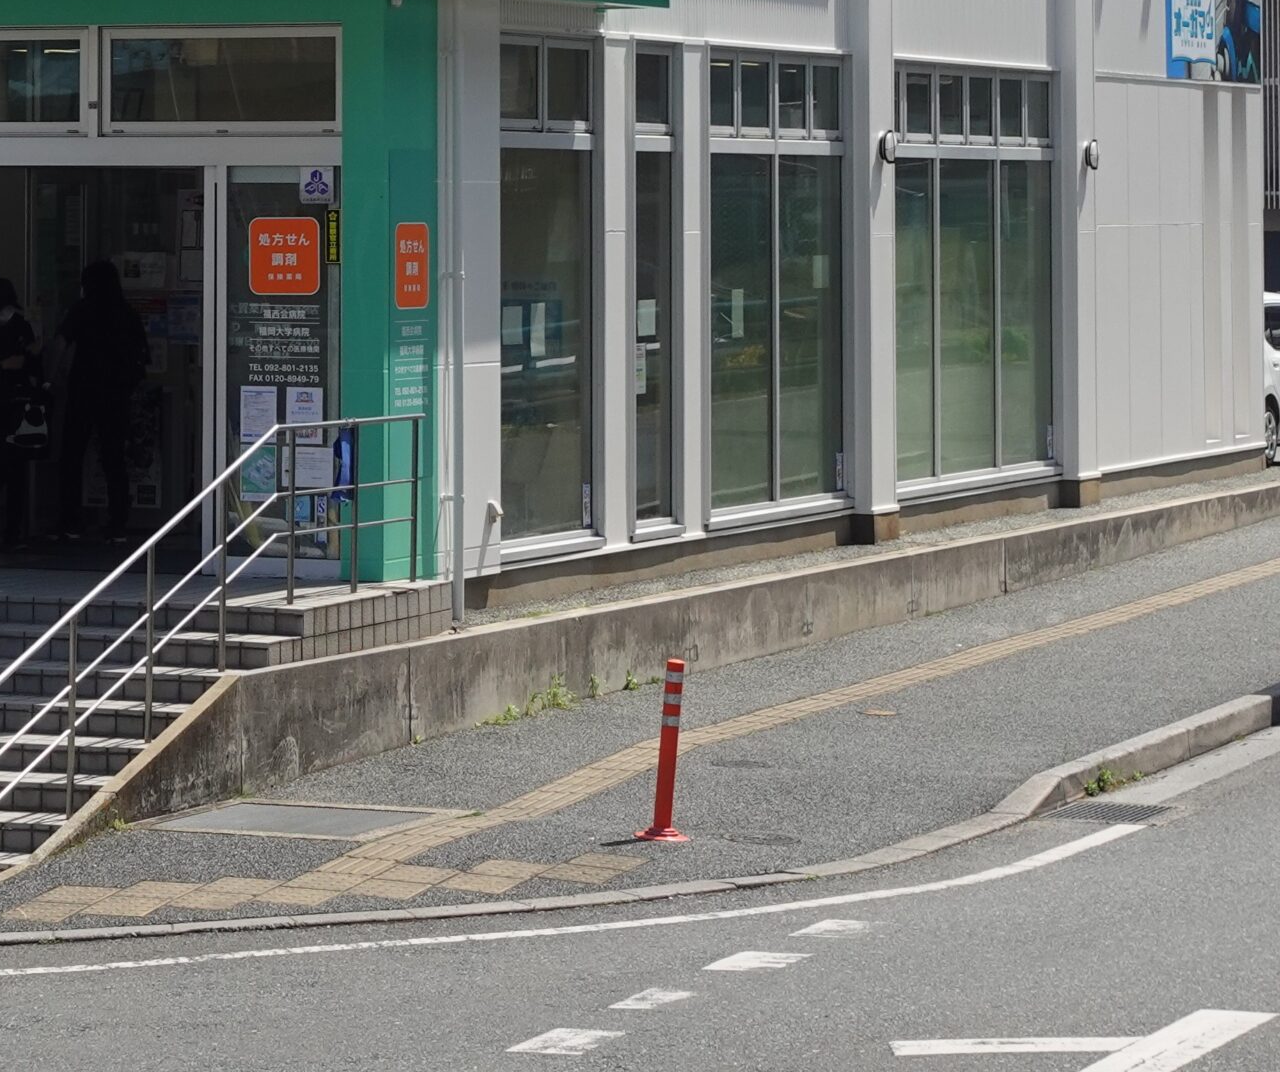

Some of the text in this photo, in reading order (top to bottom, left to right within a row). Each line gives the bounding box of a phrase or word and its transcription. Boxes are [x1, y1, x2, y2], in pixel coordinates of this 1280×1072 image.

[258, 232, 310, 246] 処方せん
[399, 239, 425, 254] 処方せん
[271, 252, 297, 266] 調剤
[259, 327, 310, 337] 福岡大学病院
[248, 363, 319, 373] TEL 092-801-2135
[248, 374, 264, 383] FAX
